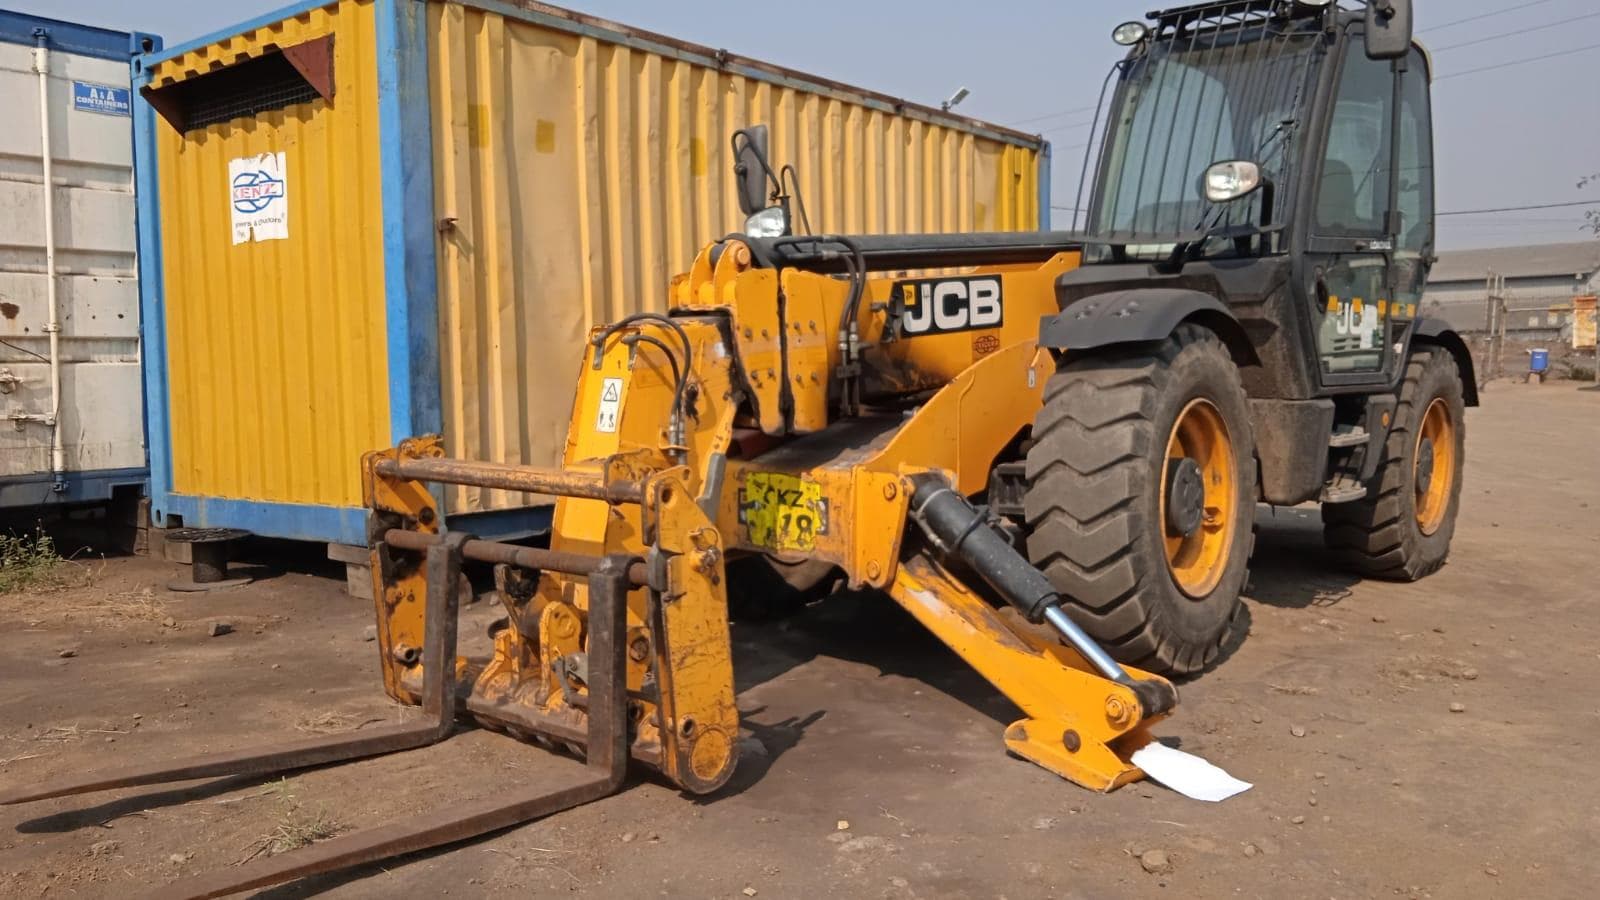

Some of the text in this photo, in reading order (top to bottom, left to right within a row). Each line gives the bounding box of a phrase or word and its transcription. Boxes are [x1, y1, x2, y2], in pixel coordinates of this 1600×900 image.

[90, 87, 98, 99] A
[106, 90, 115, 101] A
[76, 96, 128, 109] CONTAINERS
[903, 279, 1000, 333] JCB
